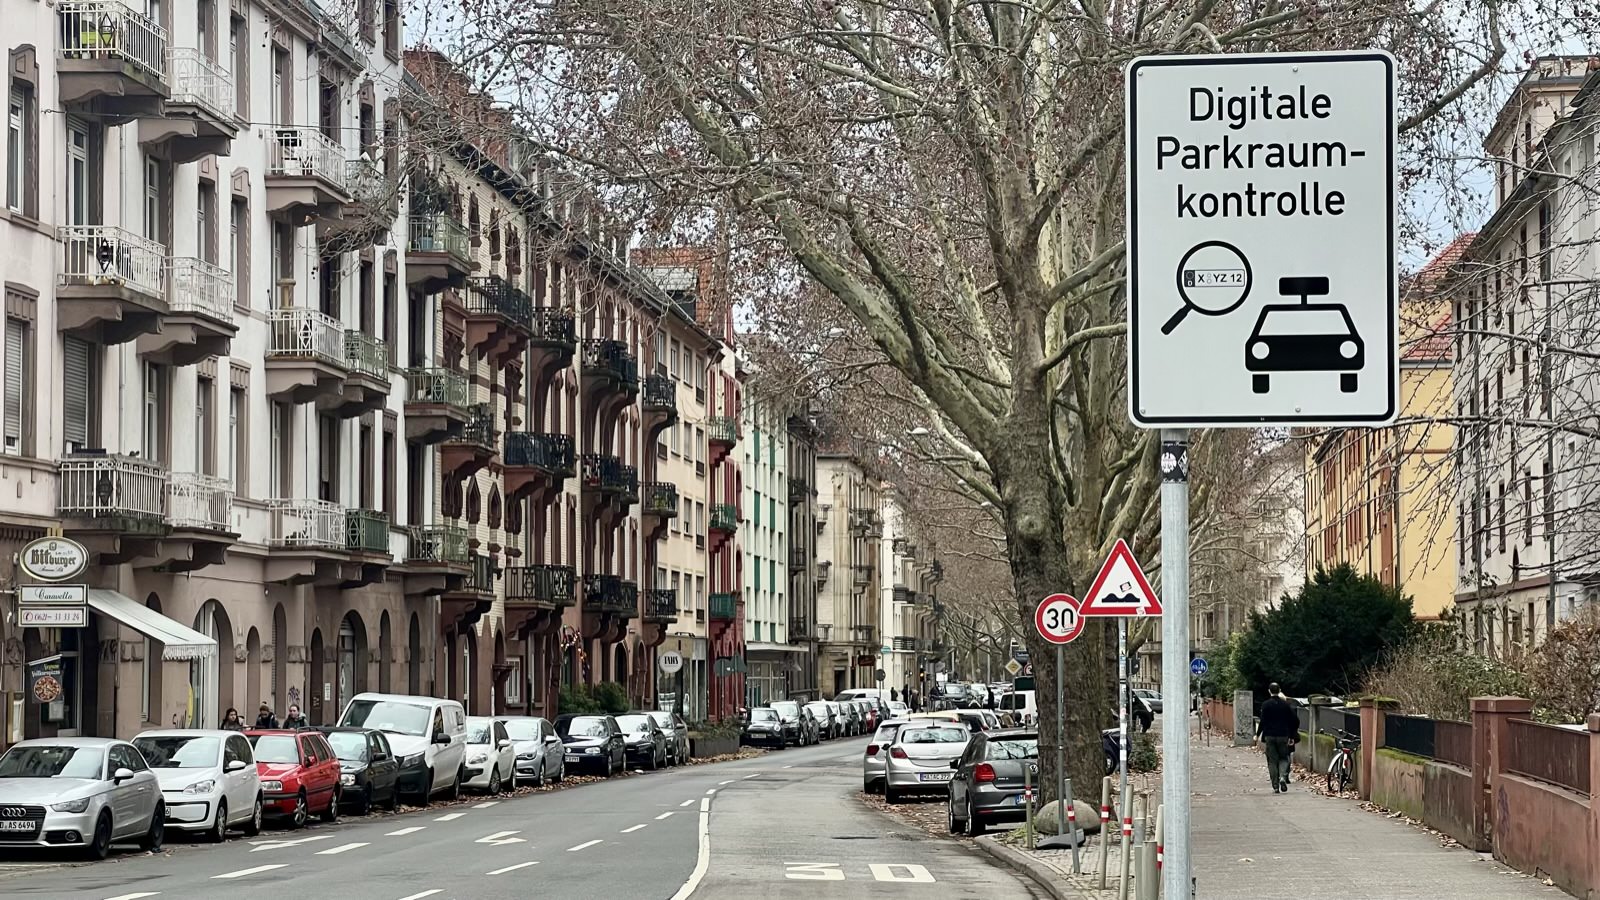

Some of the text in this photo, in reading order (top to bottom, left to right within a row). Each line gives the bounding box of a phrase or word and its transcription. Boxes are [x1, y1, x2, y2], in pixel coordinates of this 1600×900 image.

[1190, 85, 1332, 130] Digitale
[1157, 135, 1366, 170] Parkraum-
[1177, 182, 1346, 218] kontrolle
[1198, 273, 1242, 283] X YZ 12
[30, 548, 77, 568] Bitburger
[1047, 608, 1072, 629] 30
[9, 821, 17, 829] AS
[18, 821, 35, 829] 6494
[784, 862, 937, 882] 30
